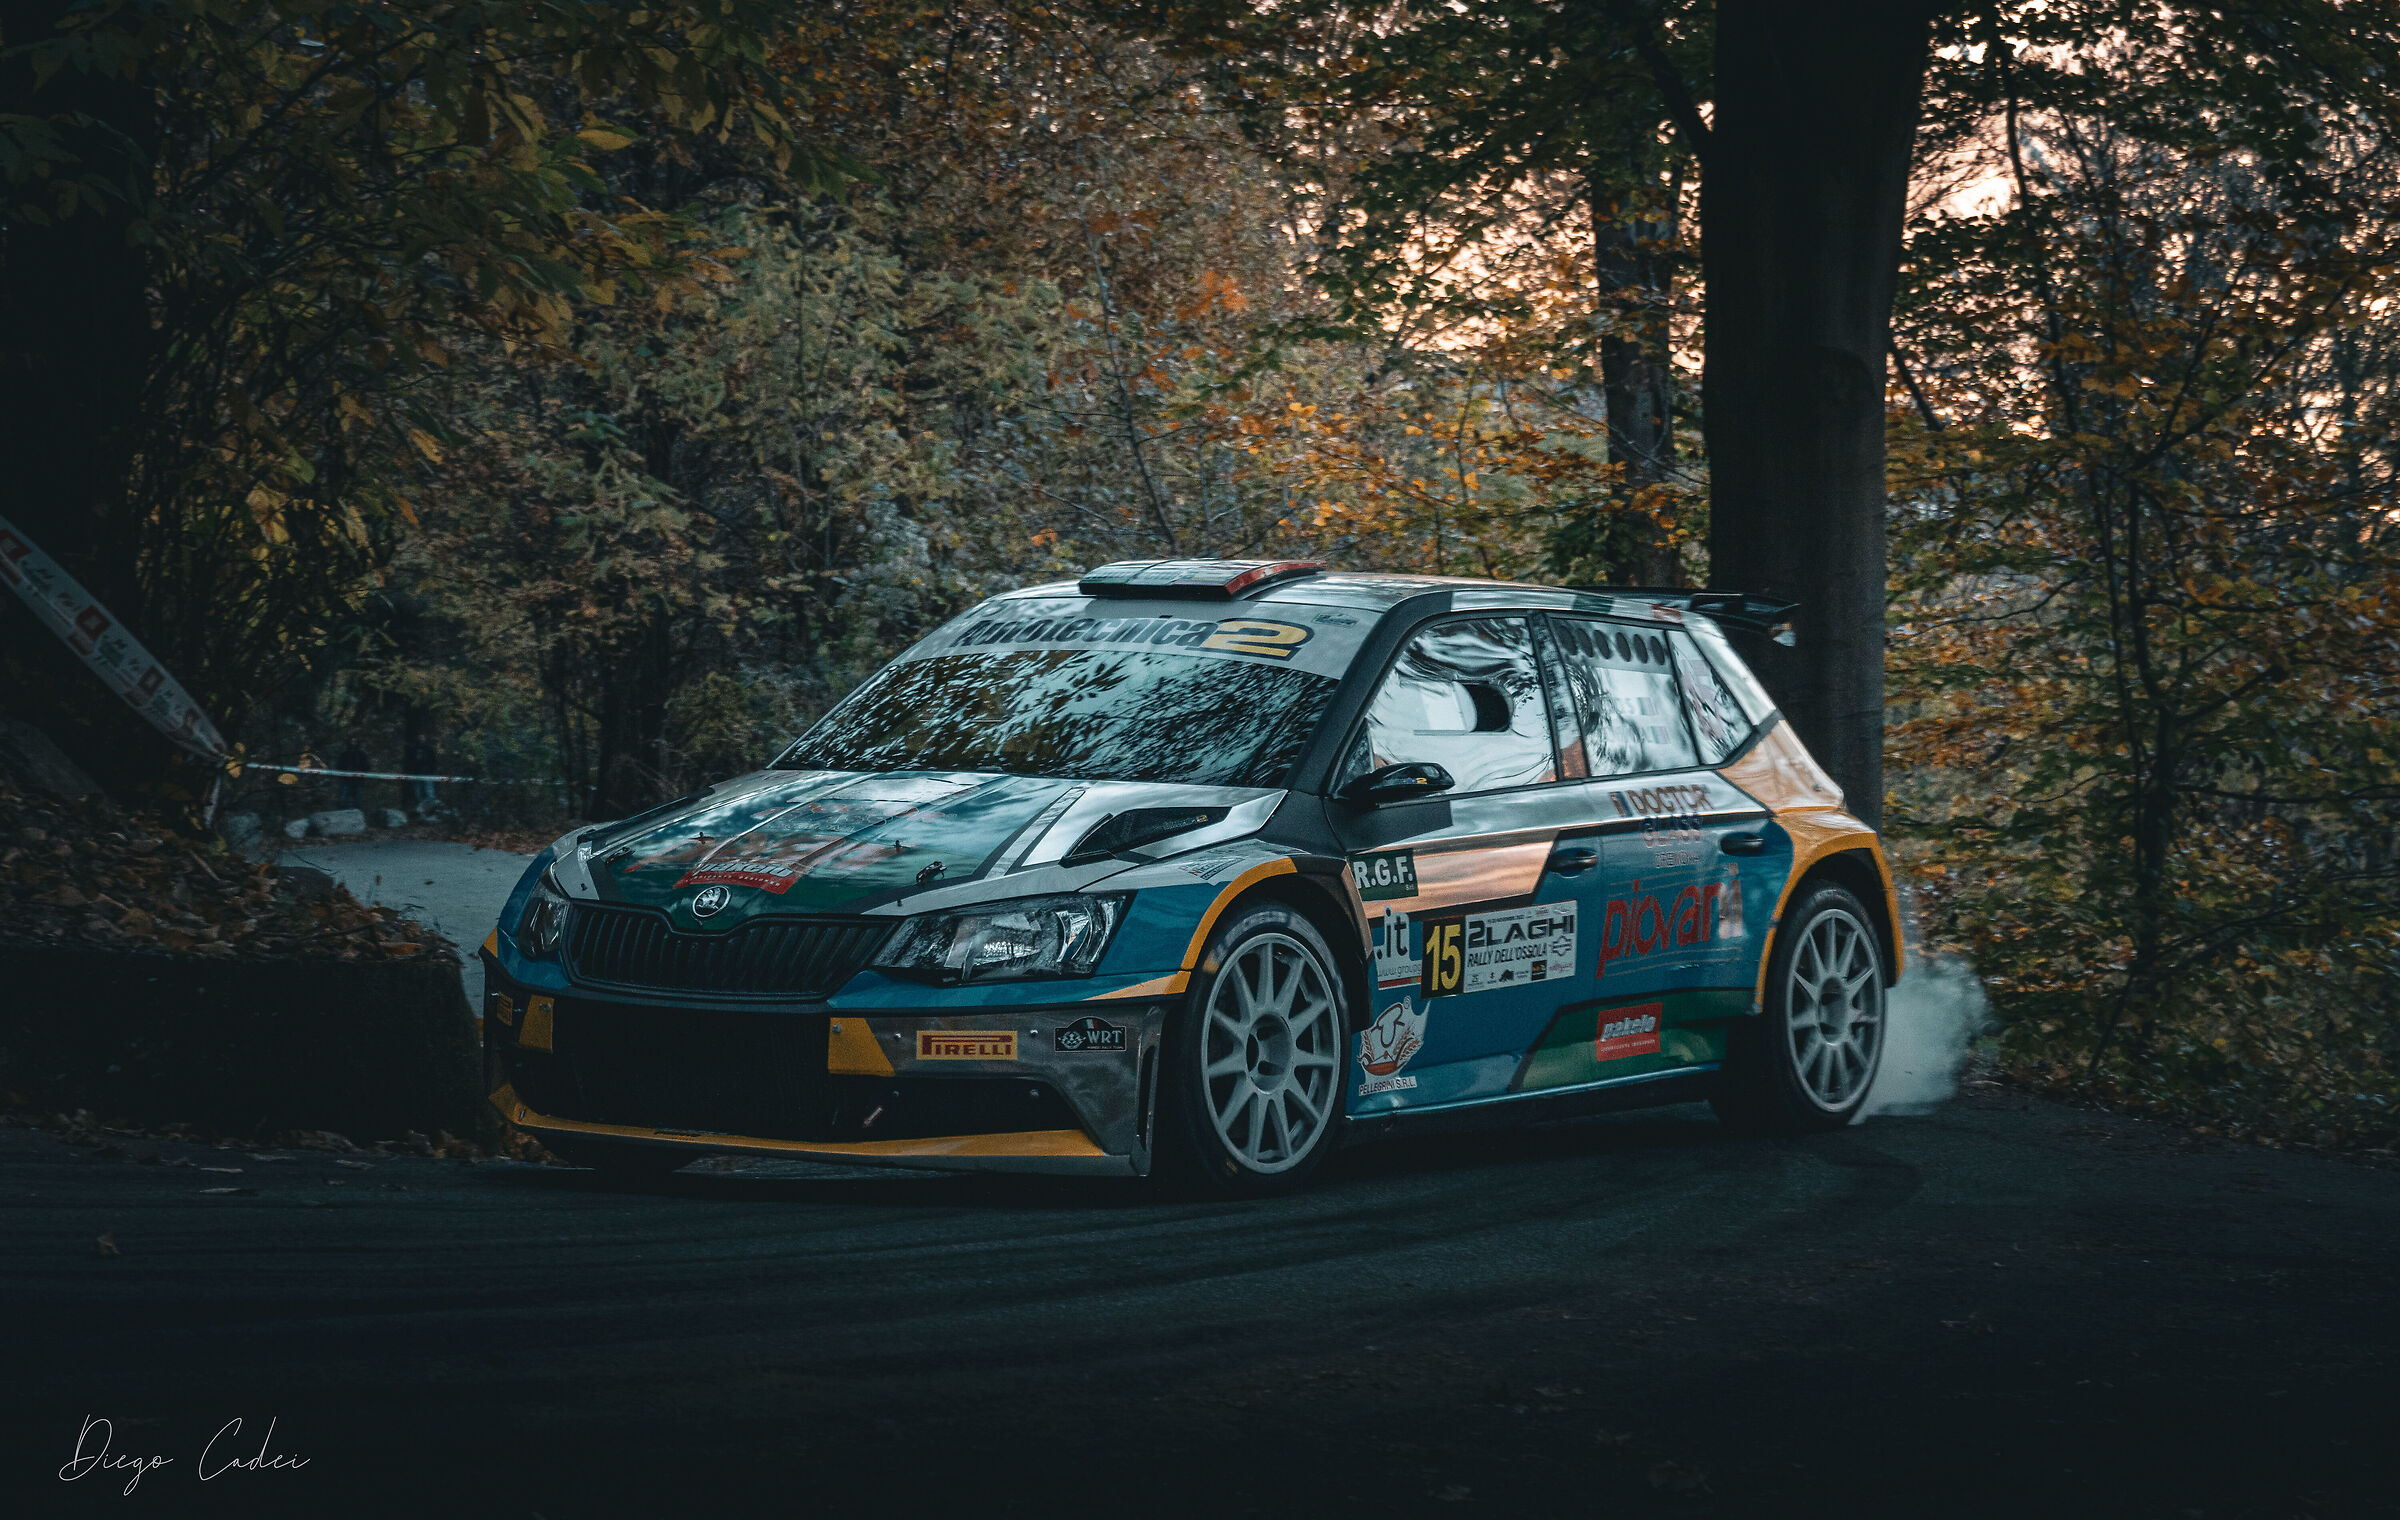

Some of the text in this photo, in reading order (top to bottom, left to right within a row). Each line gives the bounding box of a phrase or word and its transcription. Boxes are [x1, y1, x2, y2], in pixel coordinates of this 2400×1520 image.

[1626, 784, 1714, 815] DOCTOR
[1353, 856, 1414, 889] R.G.F.
[1377, 907, 1408, 960] .it
[1595, 862, 1743, 979] piovani
[1426, 924, 1461, 991] 15
[1467, 950, 1493, 968] RALLY
[922, 1035, 1013, 1056] PIRELLI
[1086, 1030, 1123, 1044] WRT
[1359, 1081, 1395, 1095] PELLEGRINI
